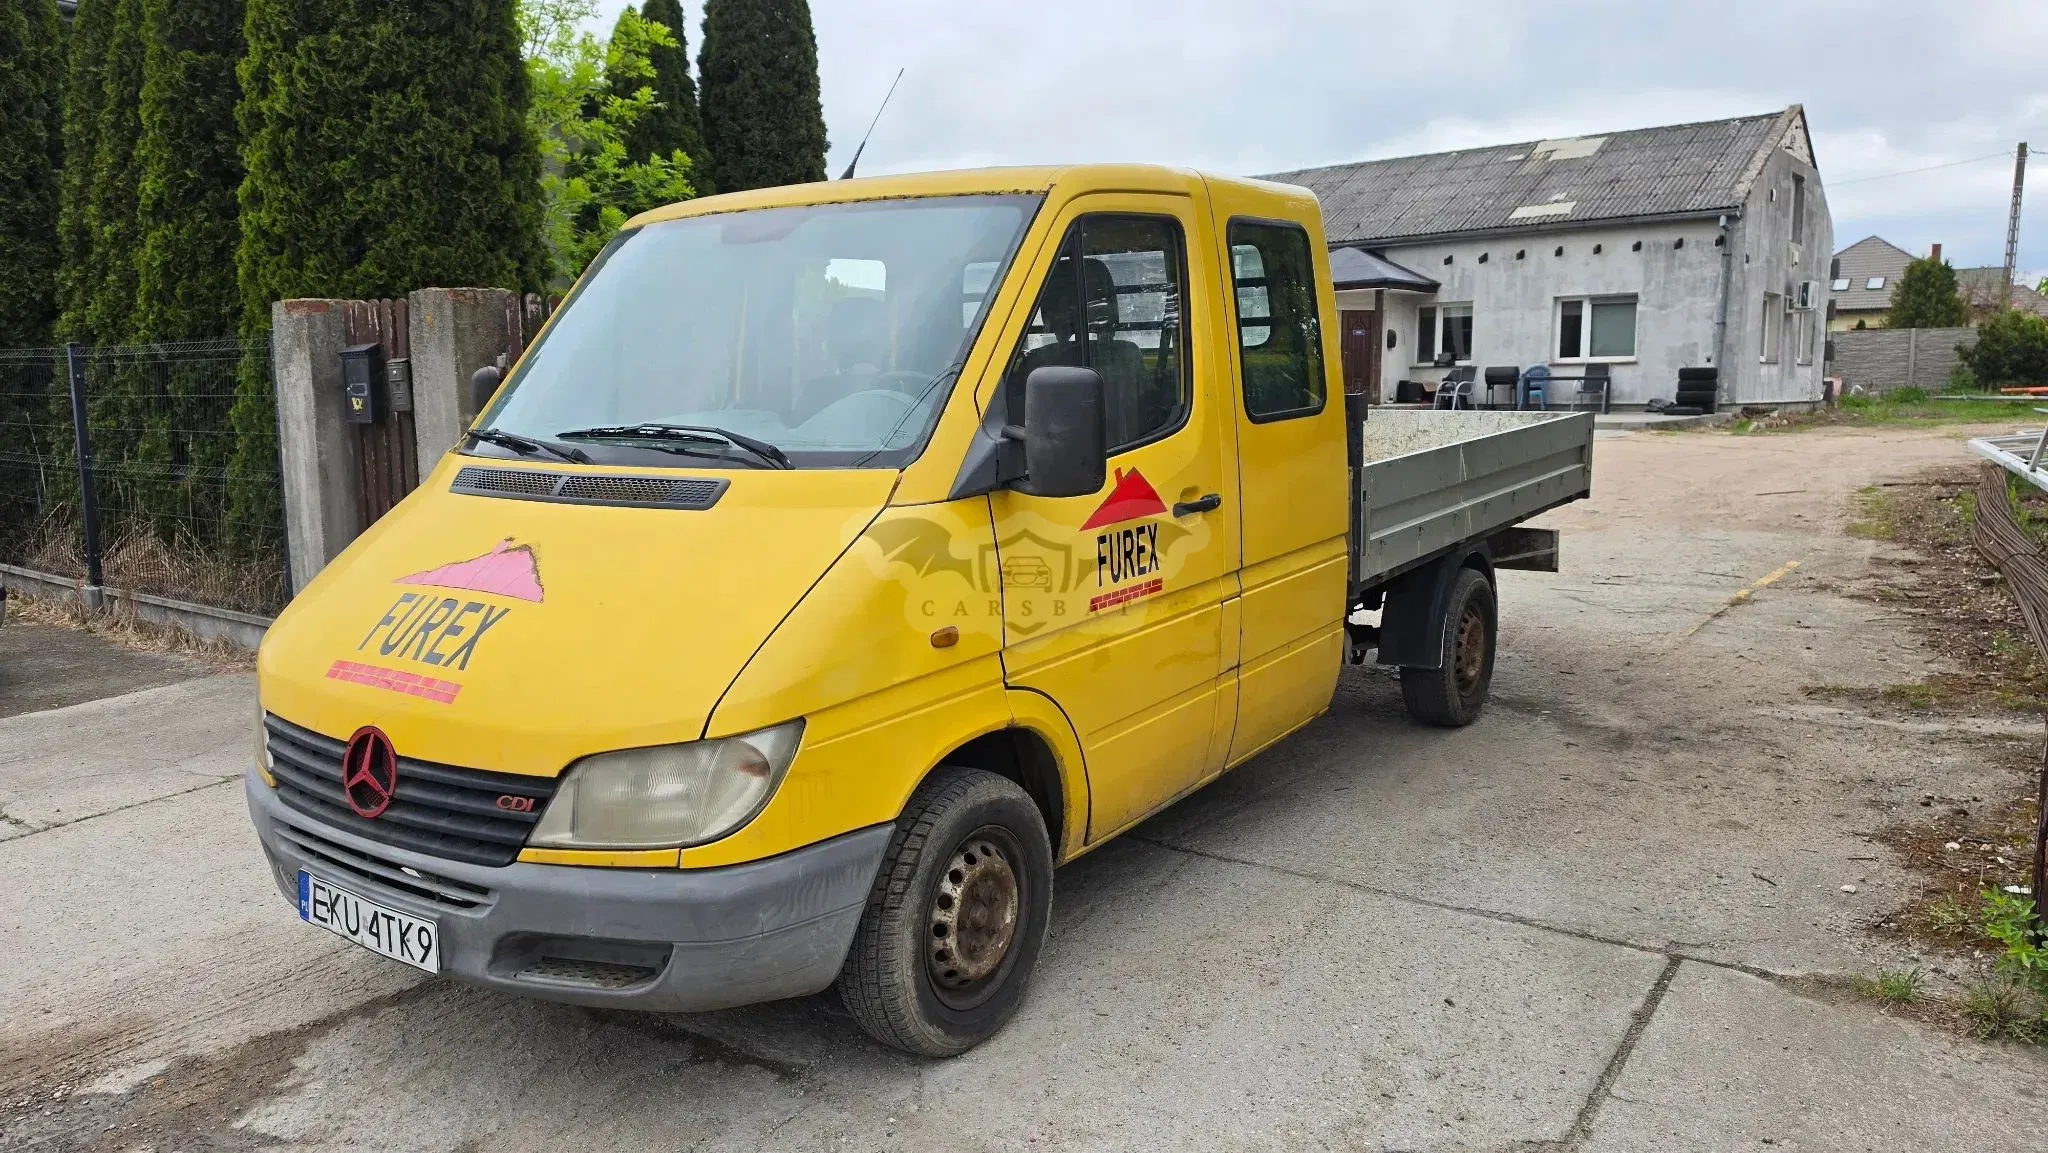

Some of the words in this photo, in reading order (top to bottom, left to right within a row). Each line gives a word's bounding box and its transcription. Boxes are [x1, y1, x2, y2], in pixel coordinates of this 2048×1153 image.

[1097, 523, 1160, 587] FUREX
[358, 593, 511, 671] FUREX
[496, 795, 535, 812] CDI
[313, 882, 360, 936] EKU
[369, 910, 432, 963] 4TK9
